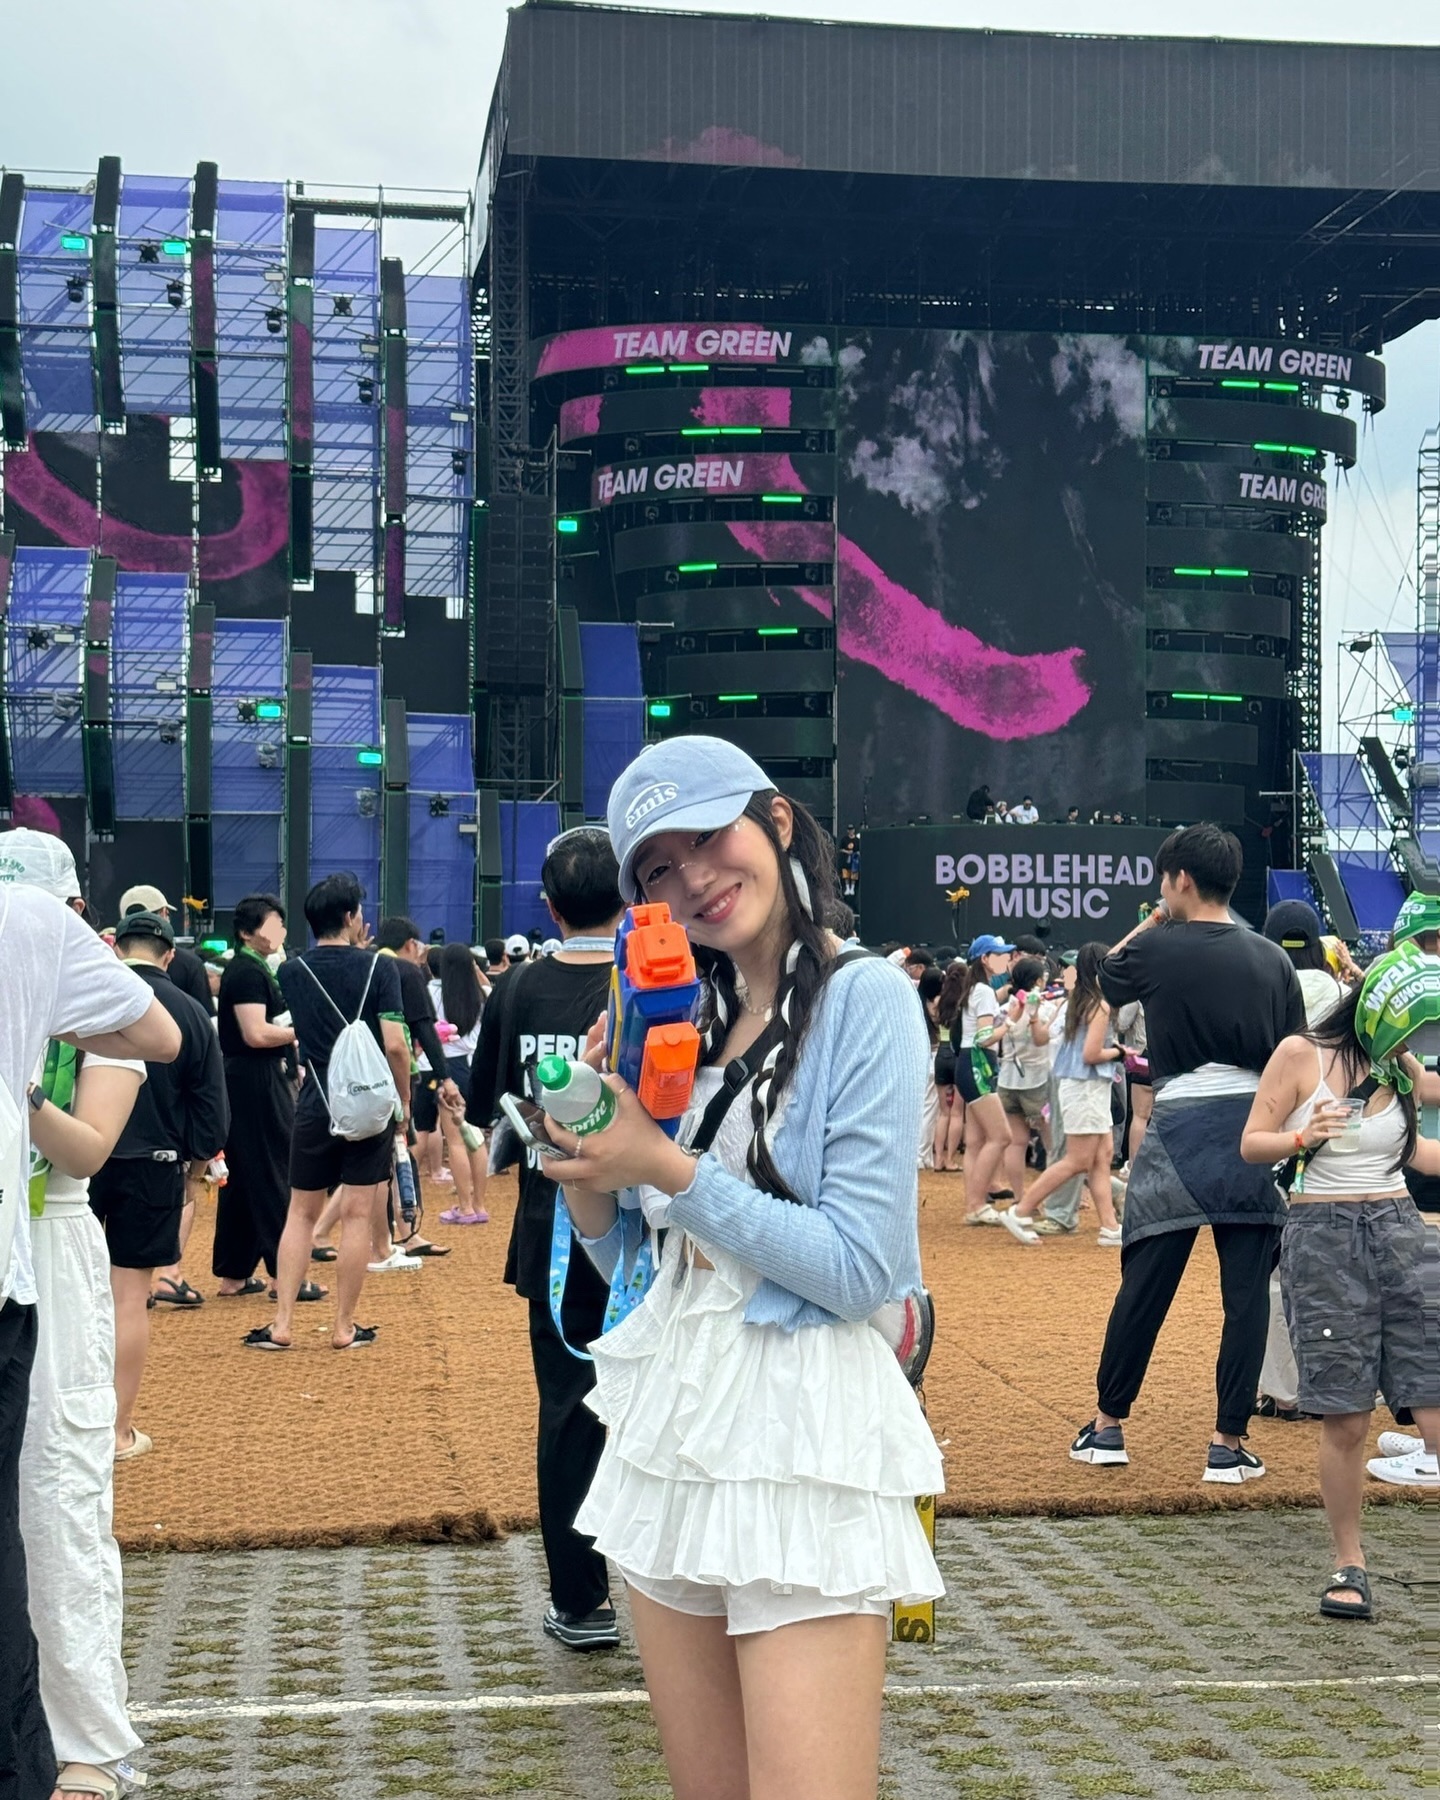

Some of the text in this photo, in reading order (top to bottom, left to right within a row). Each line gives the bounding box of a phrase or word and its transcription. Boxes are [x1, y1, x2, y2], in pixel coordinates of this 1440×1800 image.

[613, 330, 792, 358] TEAM GREEN
[1198, 345, 1352, 381] TEAM GREEN
[598, 461, 744, 500] TEAM GREEN
[1239, 473, 1297, 503] TEAM
[626, 787, 677, 829] emis
[935, 854, 1154, 886] BOBBLEHEAD
[992, 888, 1110, 919] MUSIC
